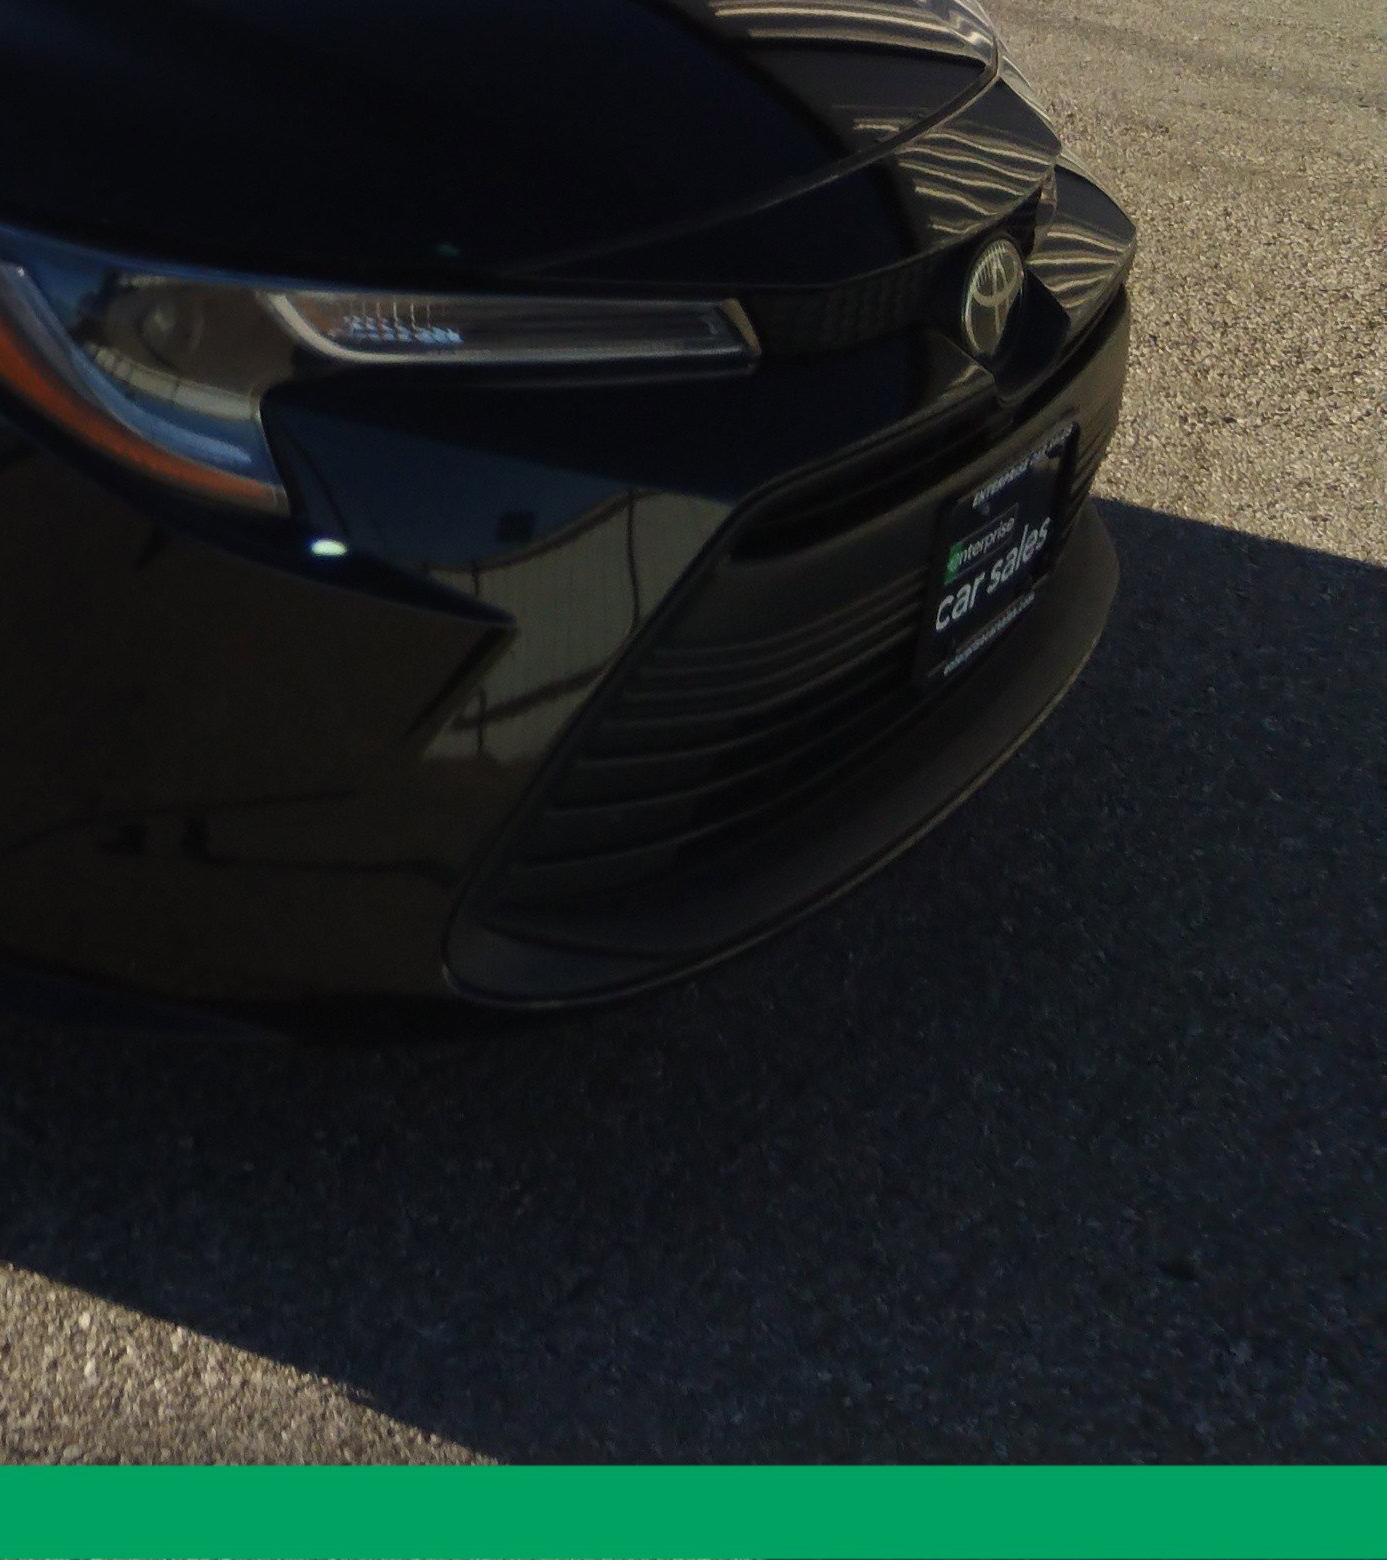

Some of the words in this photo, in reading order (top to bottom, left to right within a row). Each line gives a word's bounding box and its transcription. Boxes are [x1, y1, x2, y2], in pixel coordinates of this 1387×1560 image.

[935, 570, 986, 632] car
[986, 517, 1051, 594] sales
[948, 517, 1016, 571] enterprise
